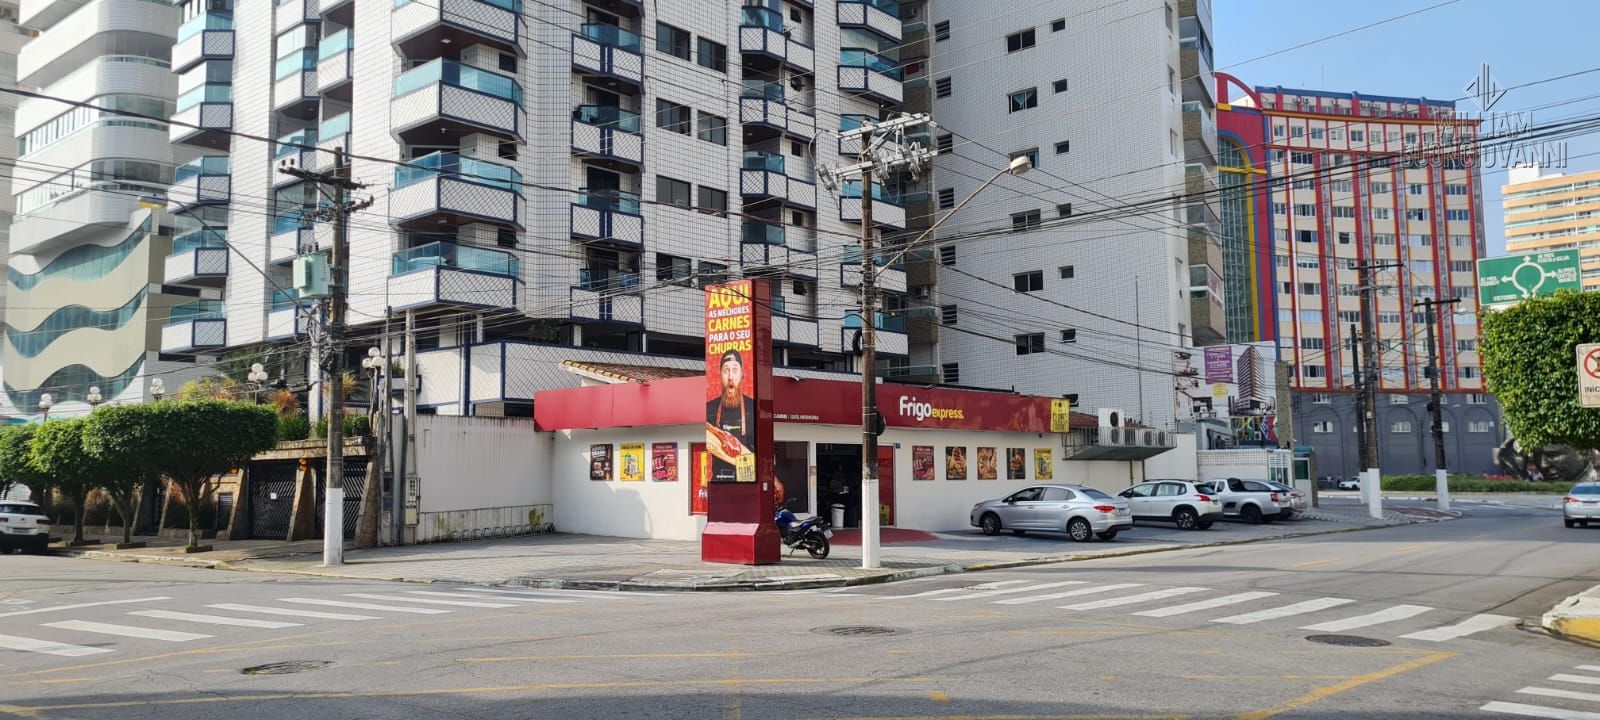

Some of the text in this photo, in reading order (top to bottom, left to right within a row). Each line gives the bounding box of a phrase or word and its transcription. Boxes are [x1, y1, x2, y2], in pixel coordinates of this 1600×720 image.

[709, 284, 749, 308] AQUI
[717, 305, 749, 316] MELHORES
[708, 315, 750, 332] CARNES
[709, 330, 750, 342] PARA O SEU
[709, 340, 751, 355] CHURRAS
[899, 395, 931, 421] Frigo
